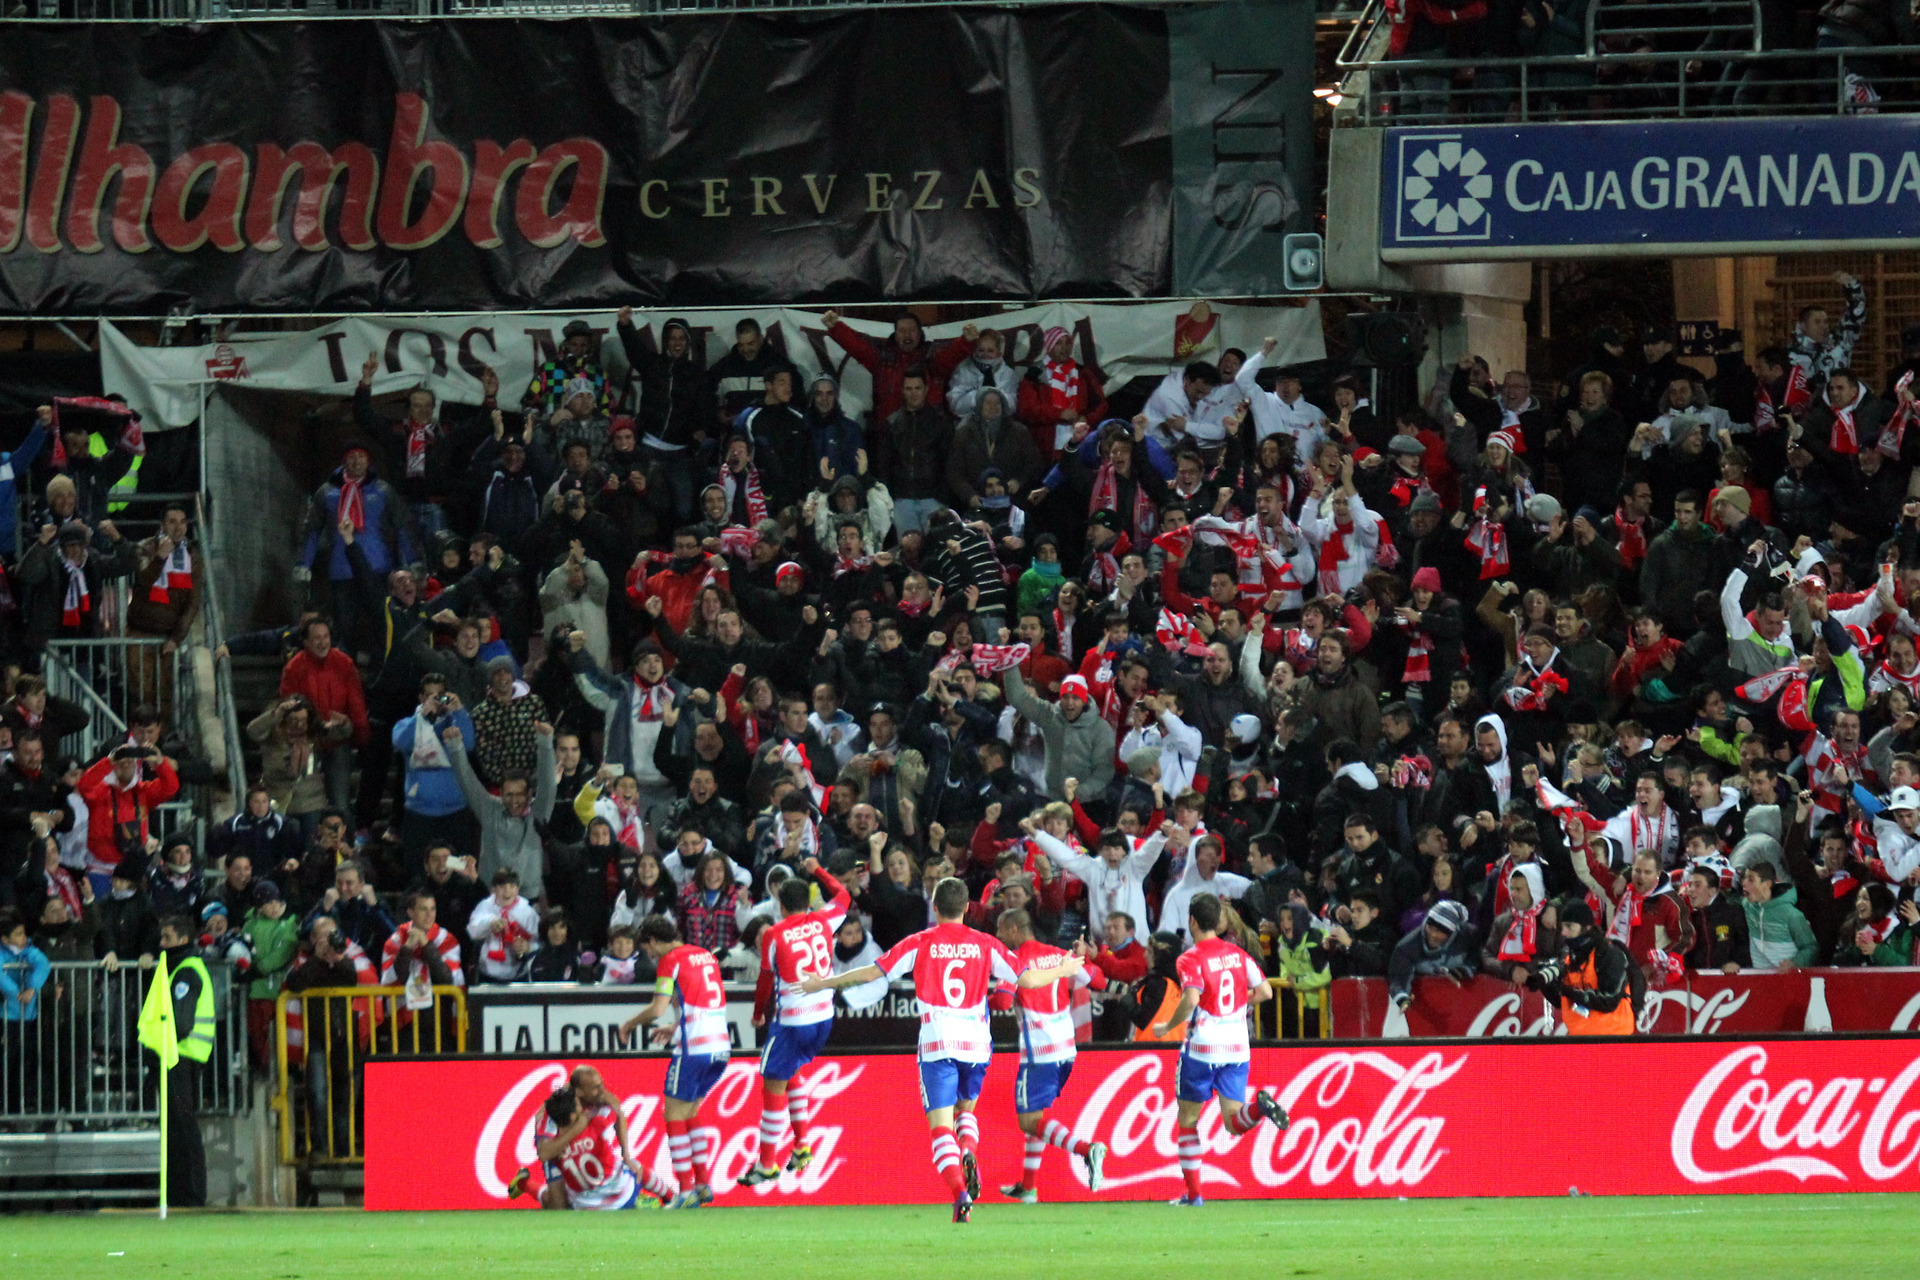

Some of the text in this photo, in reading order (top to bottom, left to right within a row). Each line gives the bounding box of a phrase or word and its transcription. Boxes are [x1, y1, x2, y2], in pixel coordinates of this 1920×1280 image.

[1211, 61, 1289, 233] SIN
[639, 166, 1044, 219] CERVEZAS
[783, 921, 824, 945] RECIO
[791, 934, 832, 984] 28
[702, 965, 722, 1009] 5
[942, 959, 967, 1009] 6
[1217, 969, 1235, 1015] 8
[563, 1152, 605, 1191] 10
